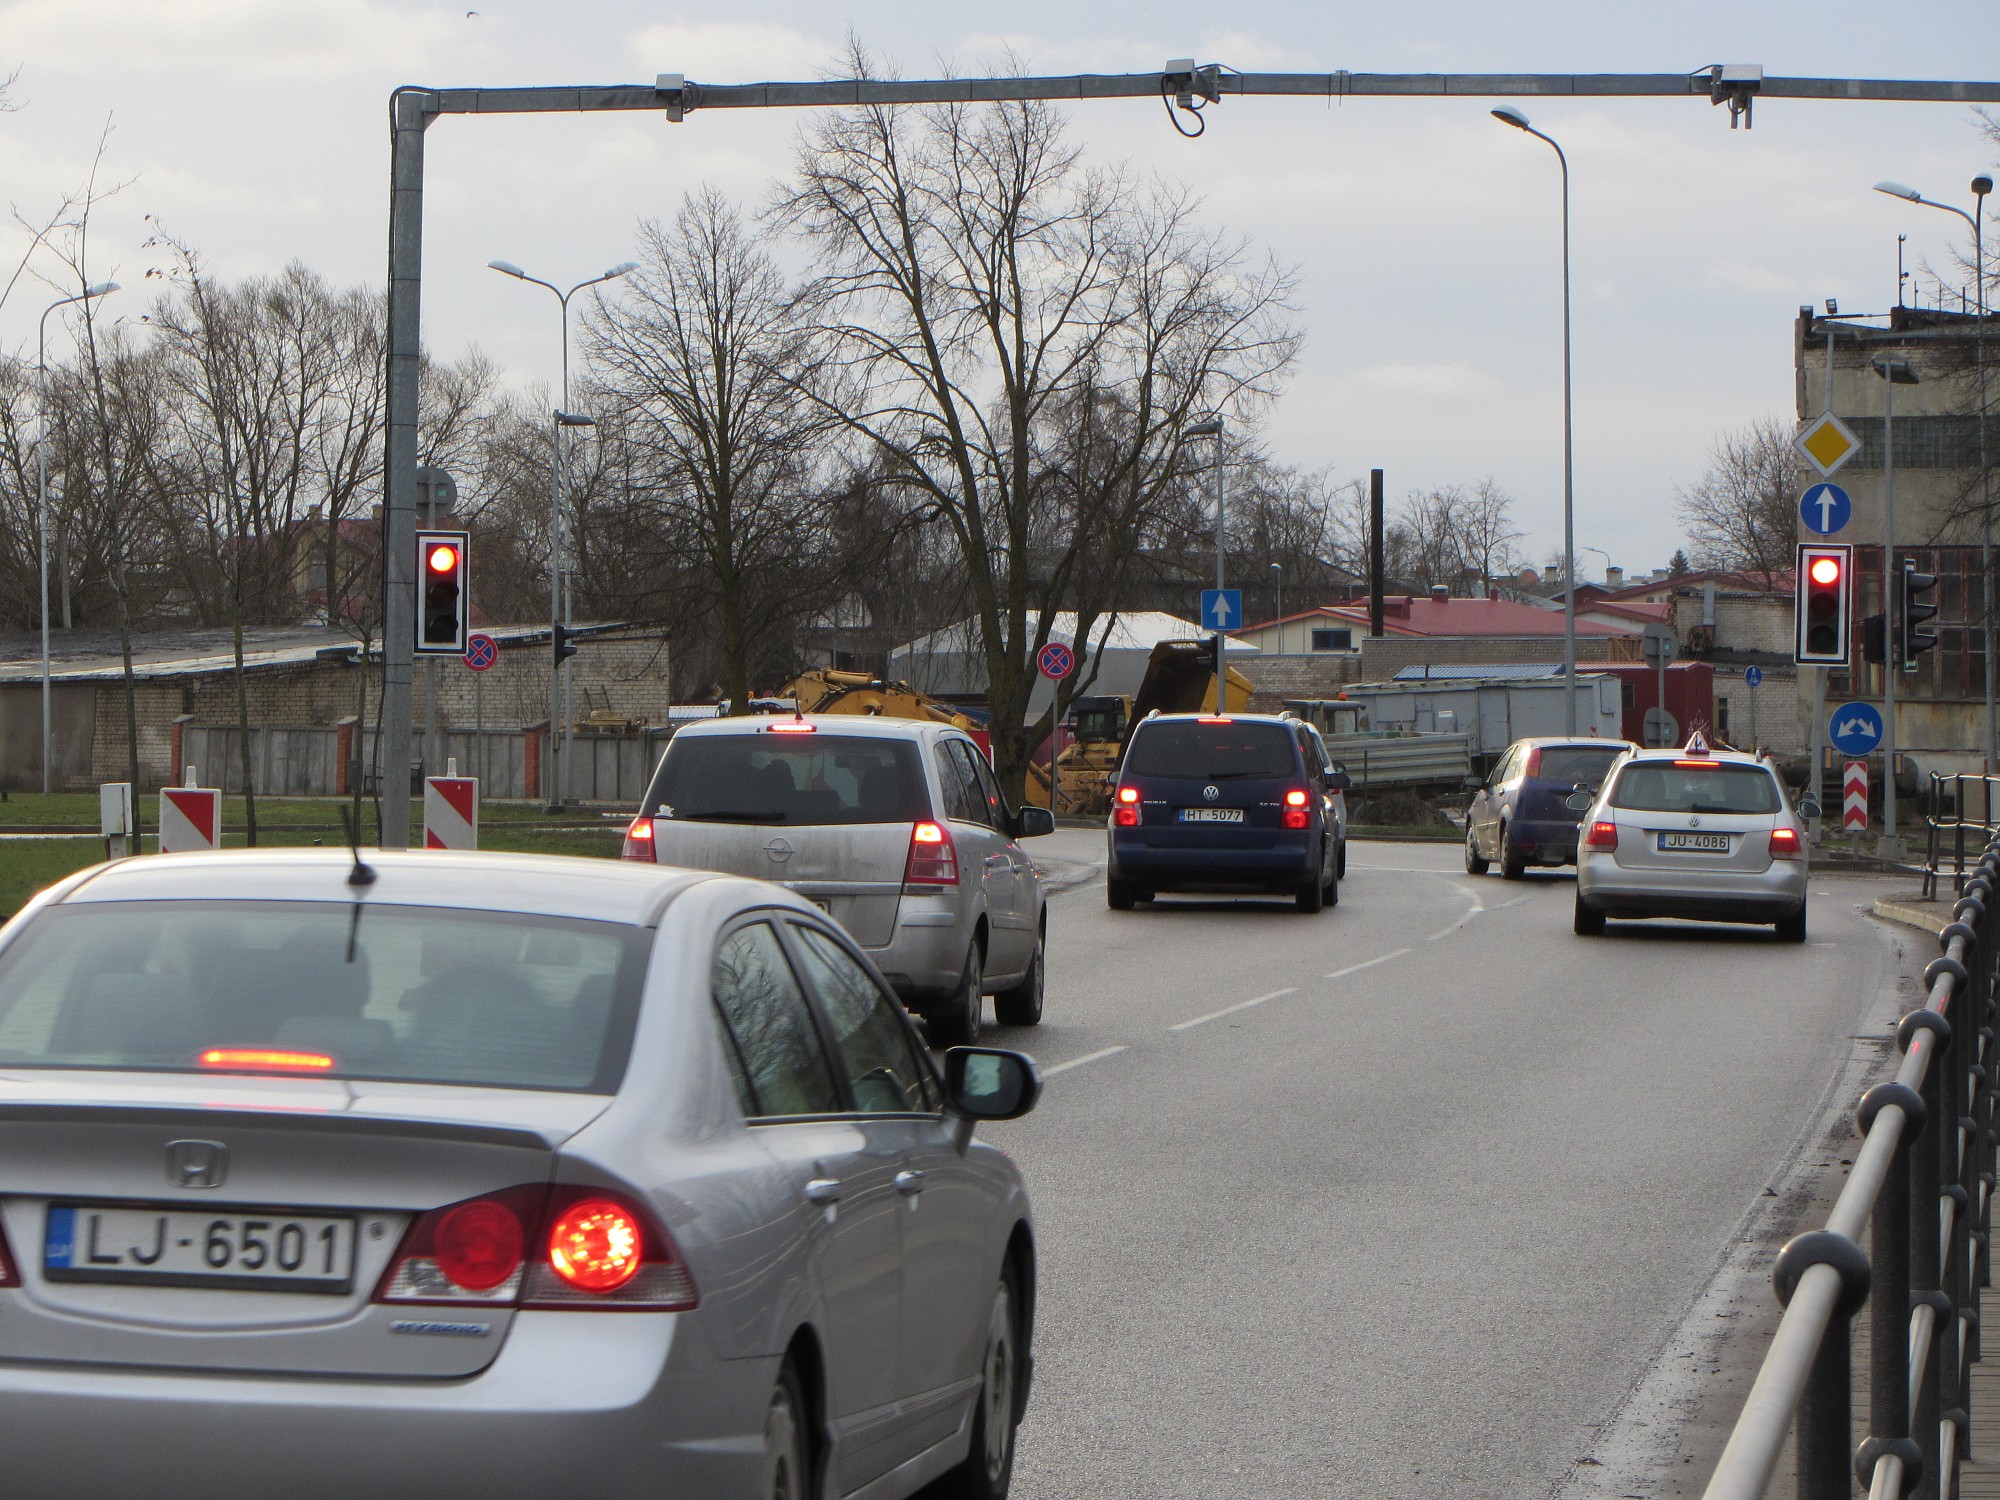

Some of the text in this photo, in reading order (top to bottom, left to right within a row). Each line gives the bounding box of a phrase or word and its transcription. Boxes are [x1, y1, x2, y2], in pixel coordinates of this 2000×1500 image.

[1186, 809, 1242, 821] HT-5077
[1668, 835, 1727, 849] JU-4086
[88, 1214, 337, 1274] LJ-6501
